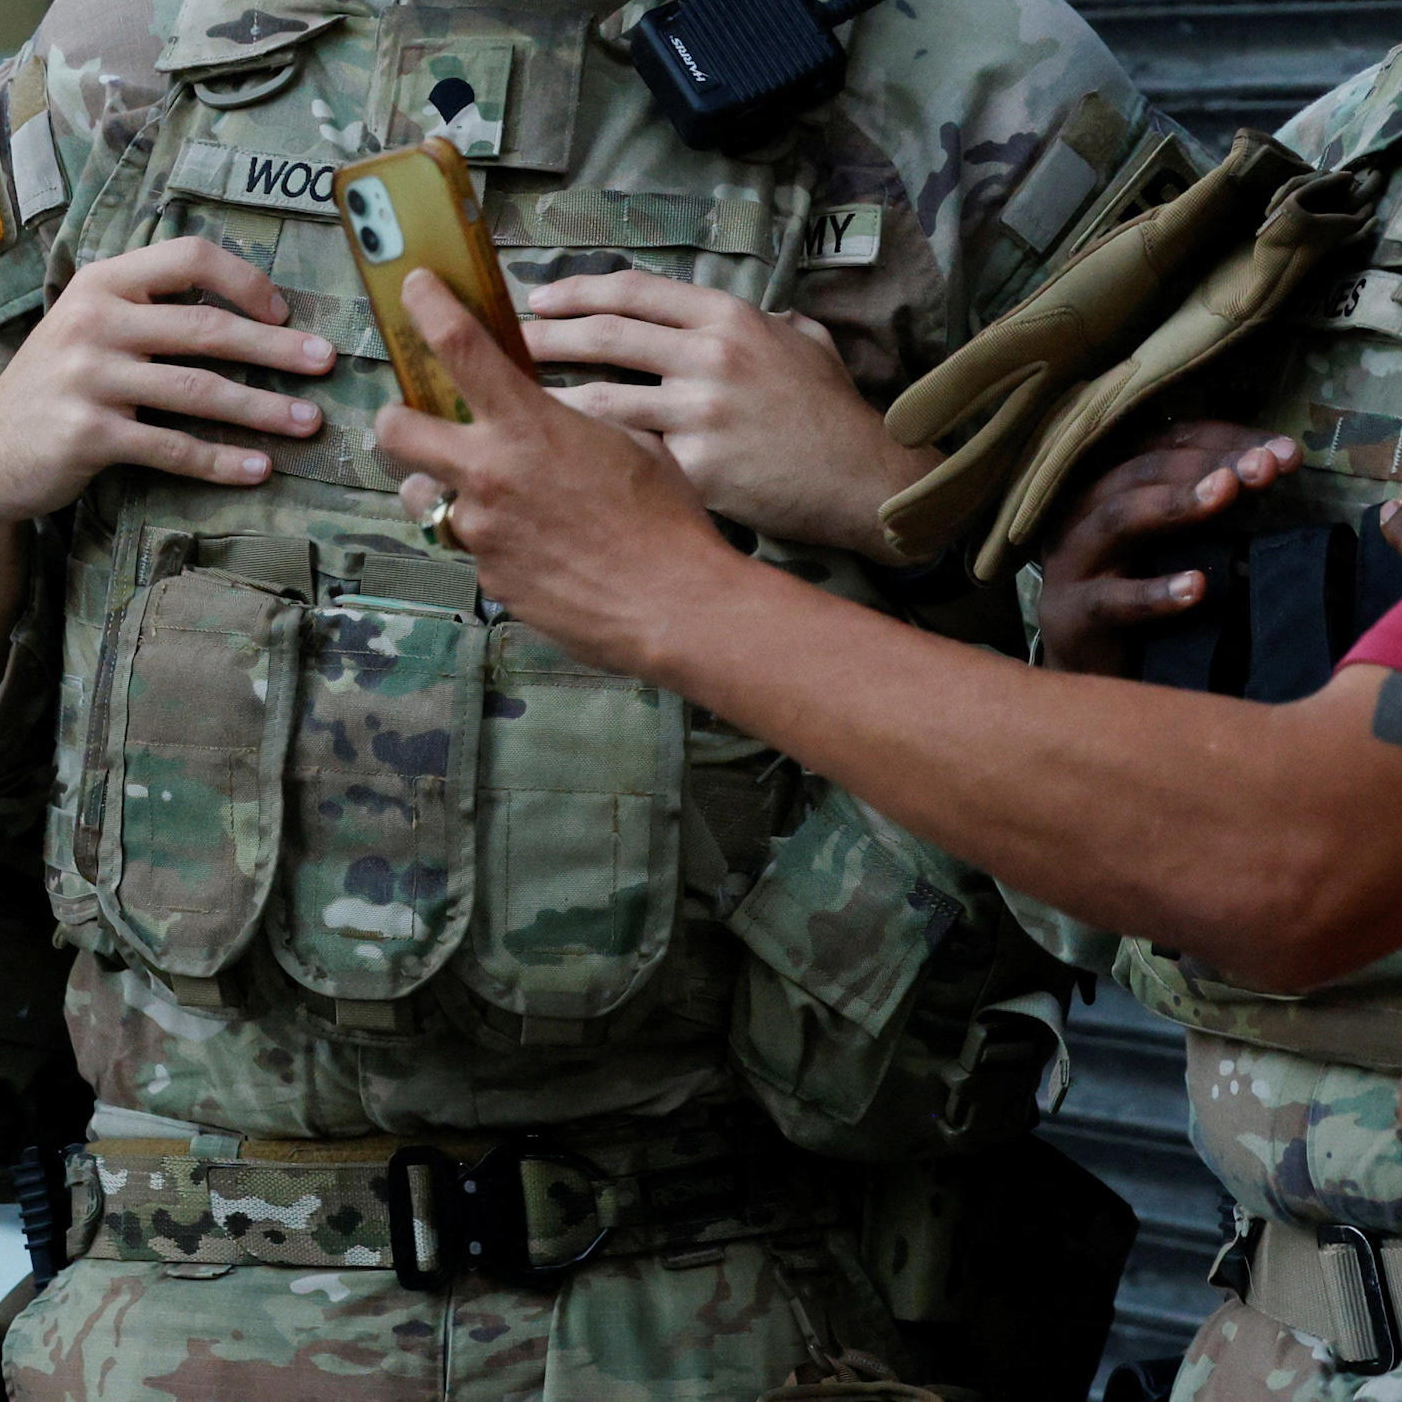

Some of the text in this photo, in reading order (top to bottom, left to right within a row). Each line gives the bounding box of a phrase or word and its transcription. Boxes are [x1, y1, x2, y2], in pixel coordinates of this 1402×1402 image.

[670, 36, 708, 82] HARRIS
[246, 156, 336, 202] WOO
[801, 212, 856, 256] MY
